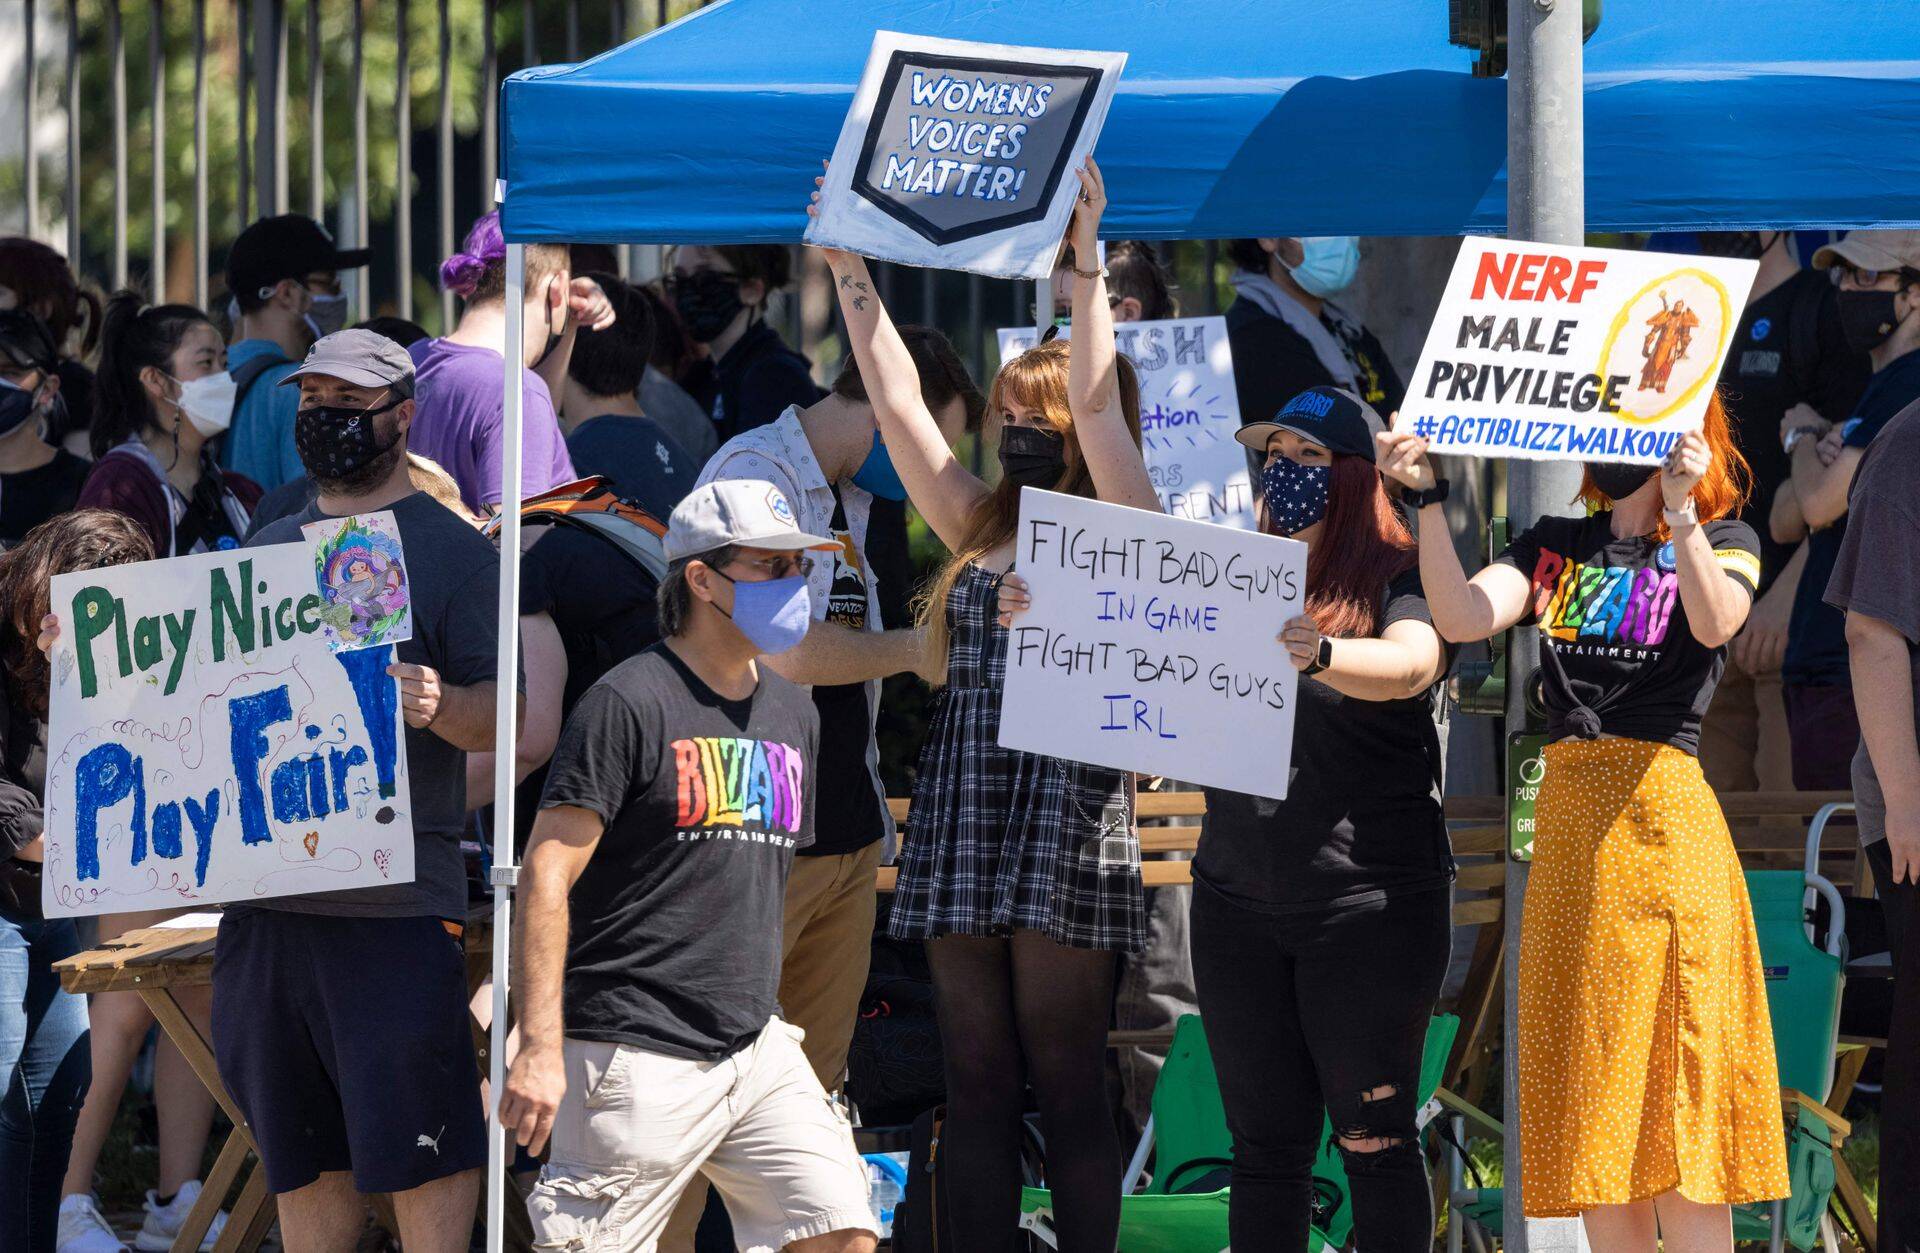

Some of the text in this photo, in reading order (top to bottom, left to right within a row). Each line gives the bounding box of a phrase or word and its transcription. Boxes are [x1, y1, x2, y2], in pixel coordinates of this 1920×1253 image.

[911, 72, 1054, 118] WOMENS
[909, 115, 1028, 160] VOICES
[881, 153, 1026, 201] MATTER!
[1470, 252, 1608, 303] NERF
[1456, 315, 1578, 355] MALE
[1425, 360, 1630, 413] PRIVILEGE
[1140, 403, 1201, 431] ation
[1413, 415, 1684, 458] #ACTIBLIZZWALKOU
[1030, 520, 1297, 601] FIGHT BAD GUYS
[72, 558, 321, 699] Play Nice
[1097, 591, 1220, 632] IN GAME
[1015, 626, 1284, 709] FIGHT BAD GUYS
[1100, 694, 1177, 738] IRL
[76, 644, 398, 888] Play Fair!
[670, 736, 803, 833] BLIZZARD
[1517, 818, 1536, 833] GRE
